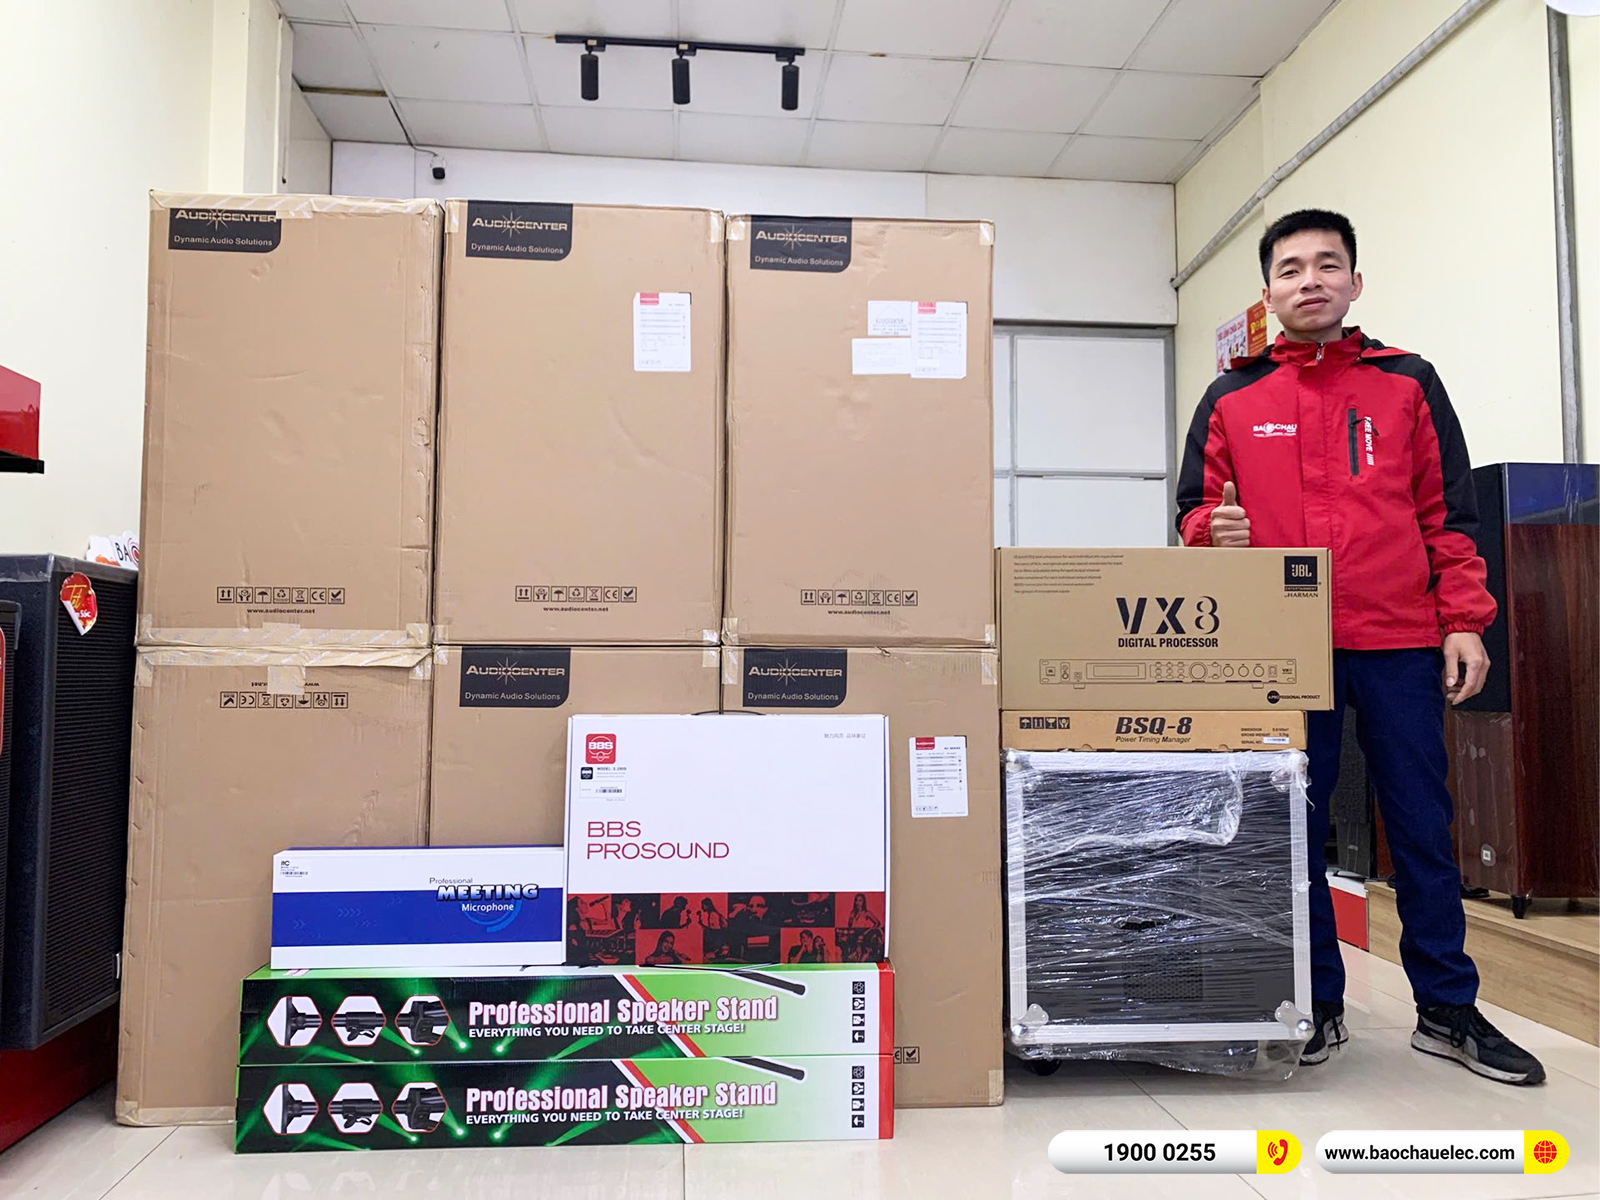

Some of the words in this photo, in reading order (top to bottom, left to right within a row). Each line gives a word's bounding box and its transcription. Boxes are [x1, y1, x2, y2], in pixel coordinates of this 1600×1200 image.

[472, 217, 568, 231] AUDIOCENTER
[174, 235, 209, 244] Dynamic
[210, 237, 234, 245] Audio
[235, 238, 273, 246] Solutions
[755, 230, 848, 243] AUDIOCENTER
[471, 243, 504, 252] Dynamic
[528, 246, 564, 254] Solutions
[754, 255, 786, 264] Dynamic
[787, 257, 809, 265] Audio
[809, 258, 844, 266] Solutions
[1291, 564, 1312, 577] JBL
[1118, 638, 1157, 648] DIGITAL
[1159, 638, 1219, 648] PROCESSOR
[465, 665, 565, 676] AUDIOCENTER
[748, 666, 843, 677] AUDIOCENTER
[465, 692, 499, 701] Dynamic
[500, 692, 523, 700] Audio
[748, 692, 780, 701] Dynamic
[804, 693, 839, 701] Solutions
[1115, 717, 1193, 735] BSQ-8
[1139, 736, 1160, 744] Timing
[1161, 736, 1191, 744] Manager
[587, 820, 642, 838] BBS
[586, 842, 730, 860] PROSOUND
[436, 883, 539, 901] MEETING
[461, 903, 514, 912] Microphone
[468, 999, 610, 1026] Professional
[616, 998, 710, 1024] Speaker
[716, 996, 778, 1021] Stand
[468, 1027, 541, 1038] EVERYTHING
[545, 1026, 569, 1036] YOU
[572, 1026, 604, 1036] NEED
[607, 1025, 622, 1035] TO
[625, 1025, 654, 1034] TAKE
[657, 1024, 701, 1034] CENTER
[704, 1023, 744, 1034] STAGE!
[466, 1085, 608, 1113] Professional
[615, 1083, 709, 1110] Speaker
[714, 1081, 777, 1106] Stand
[466, 1113, 539, 1125] EVERYTHING
[542, 1112, 567, 1123] YOU
[570, 1111, 602, 1122] NEED
[605, 1111, 620, 1121] TO
[623, 1110, 652, 1121] TAKE
[655, 1109, 700, 1120] CENTER
[702, 1108, 743, 1119] STAGE!
